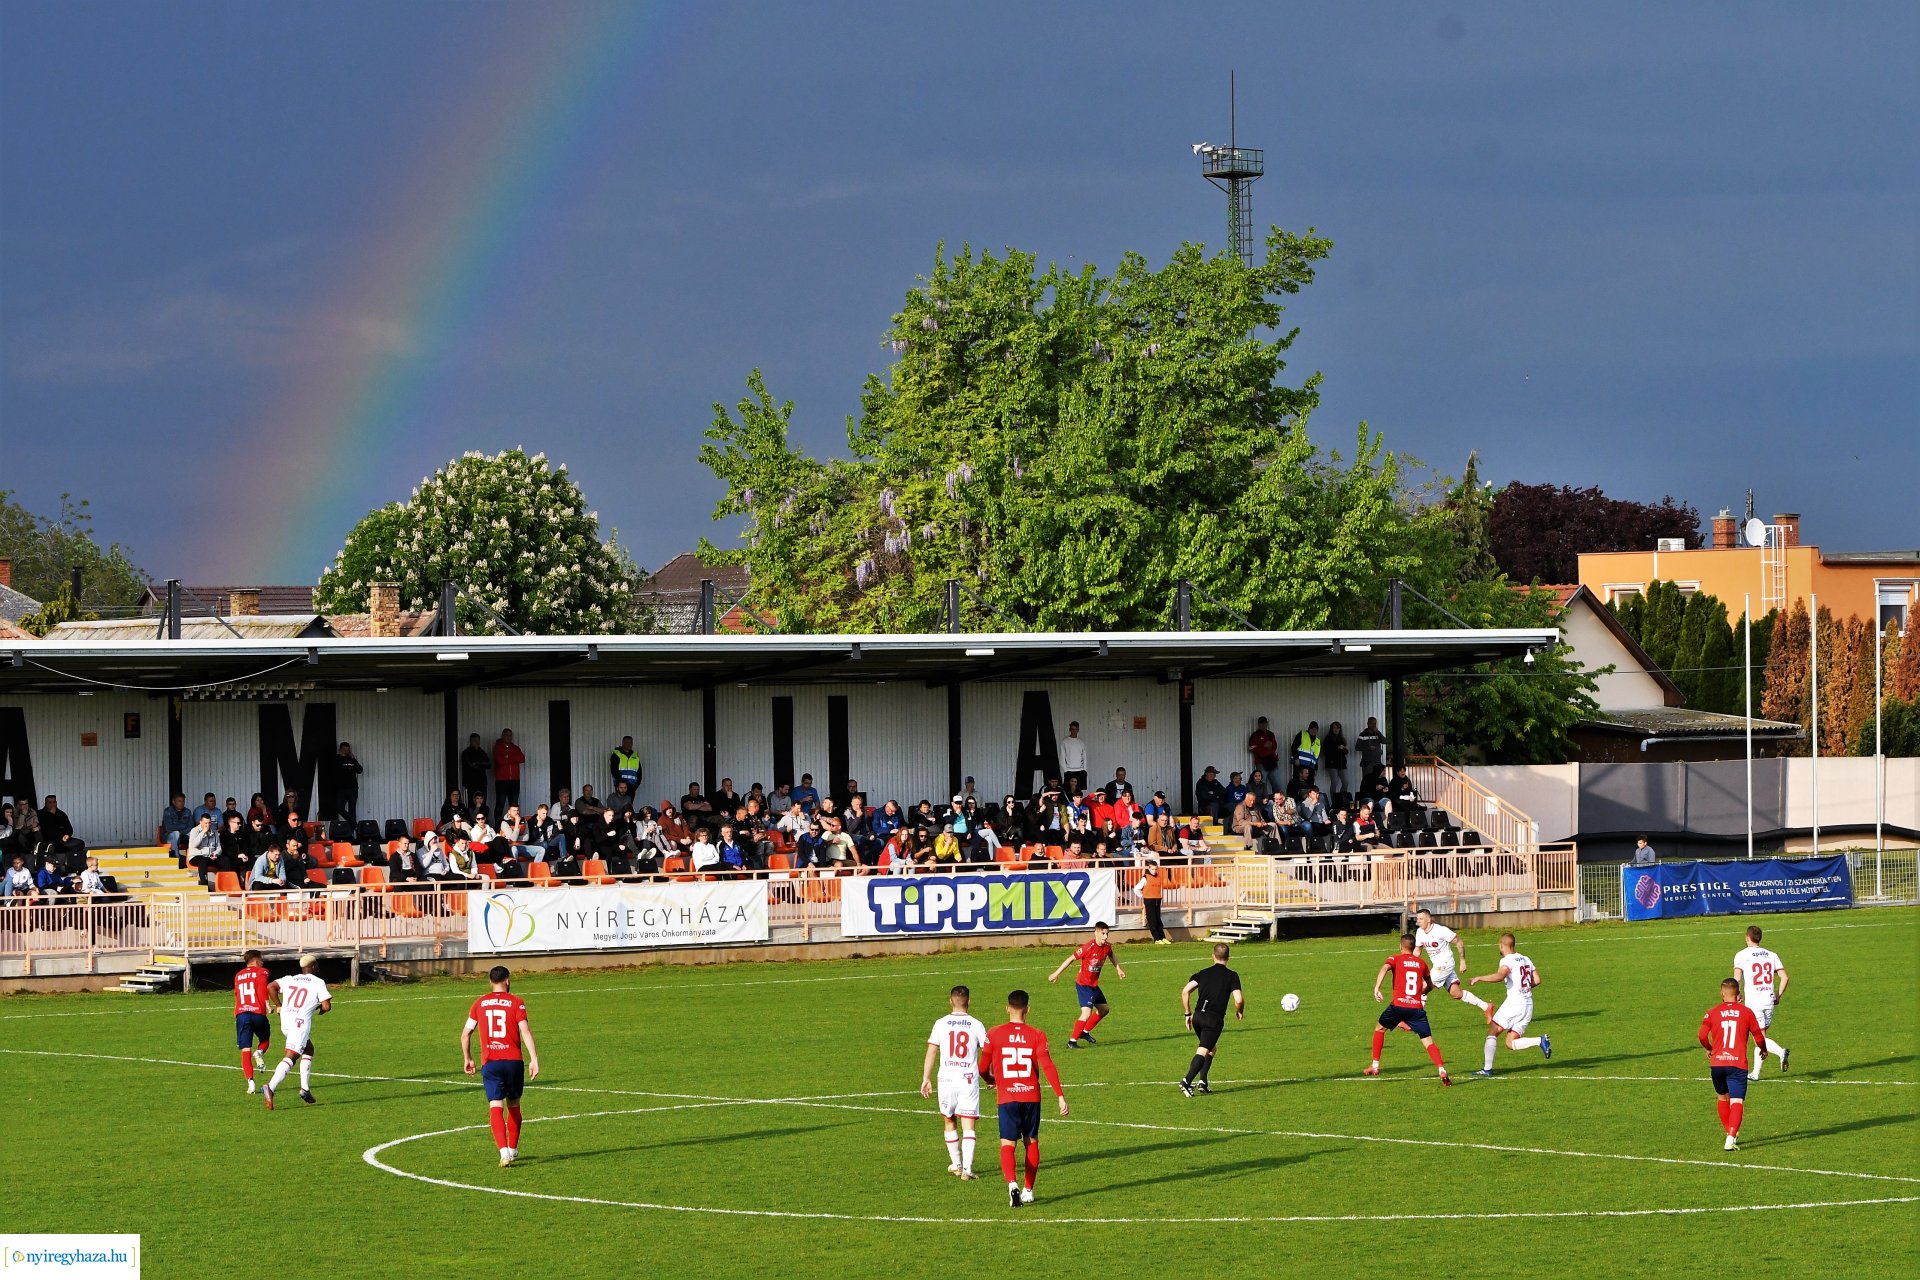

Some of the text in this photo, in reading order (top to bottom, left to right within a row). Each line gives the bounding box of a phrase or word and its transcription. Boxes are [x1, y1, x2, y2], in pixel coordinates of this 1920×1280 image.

[1663, 881, 1731, 894] PRESTIGE
[1747, 879, 1783, 888] SZAKORVOS
[1760, 888, 1774, 896] MINT
[1664, 894, 1697, 902] MEDICAL
[557, 902, 747, 930] NYÍREGYHÁZA
[593, 928, 716, 942] Megyei Jogú Város Önkormányzata
[1405, 971, 1418, 996] 8
[1752, 962, 1773, 986] 23
[238, 982, 256, 1005] 14
[287, 985, 308, 1009] 70
[485, 1009, 507, 1038] 13
[947, 1019, 972, 1027] apollo
[1720, 1009, 1740, 1018] VASS
[948, 1030, 970, 1059] 18
[1721, 1020, 1737, 1049] 11
[1001, 1047, 1033, 1079] 25
